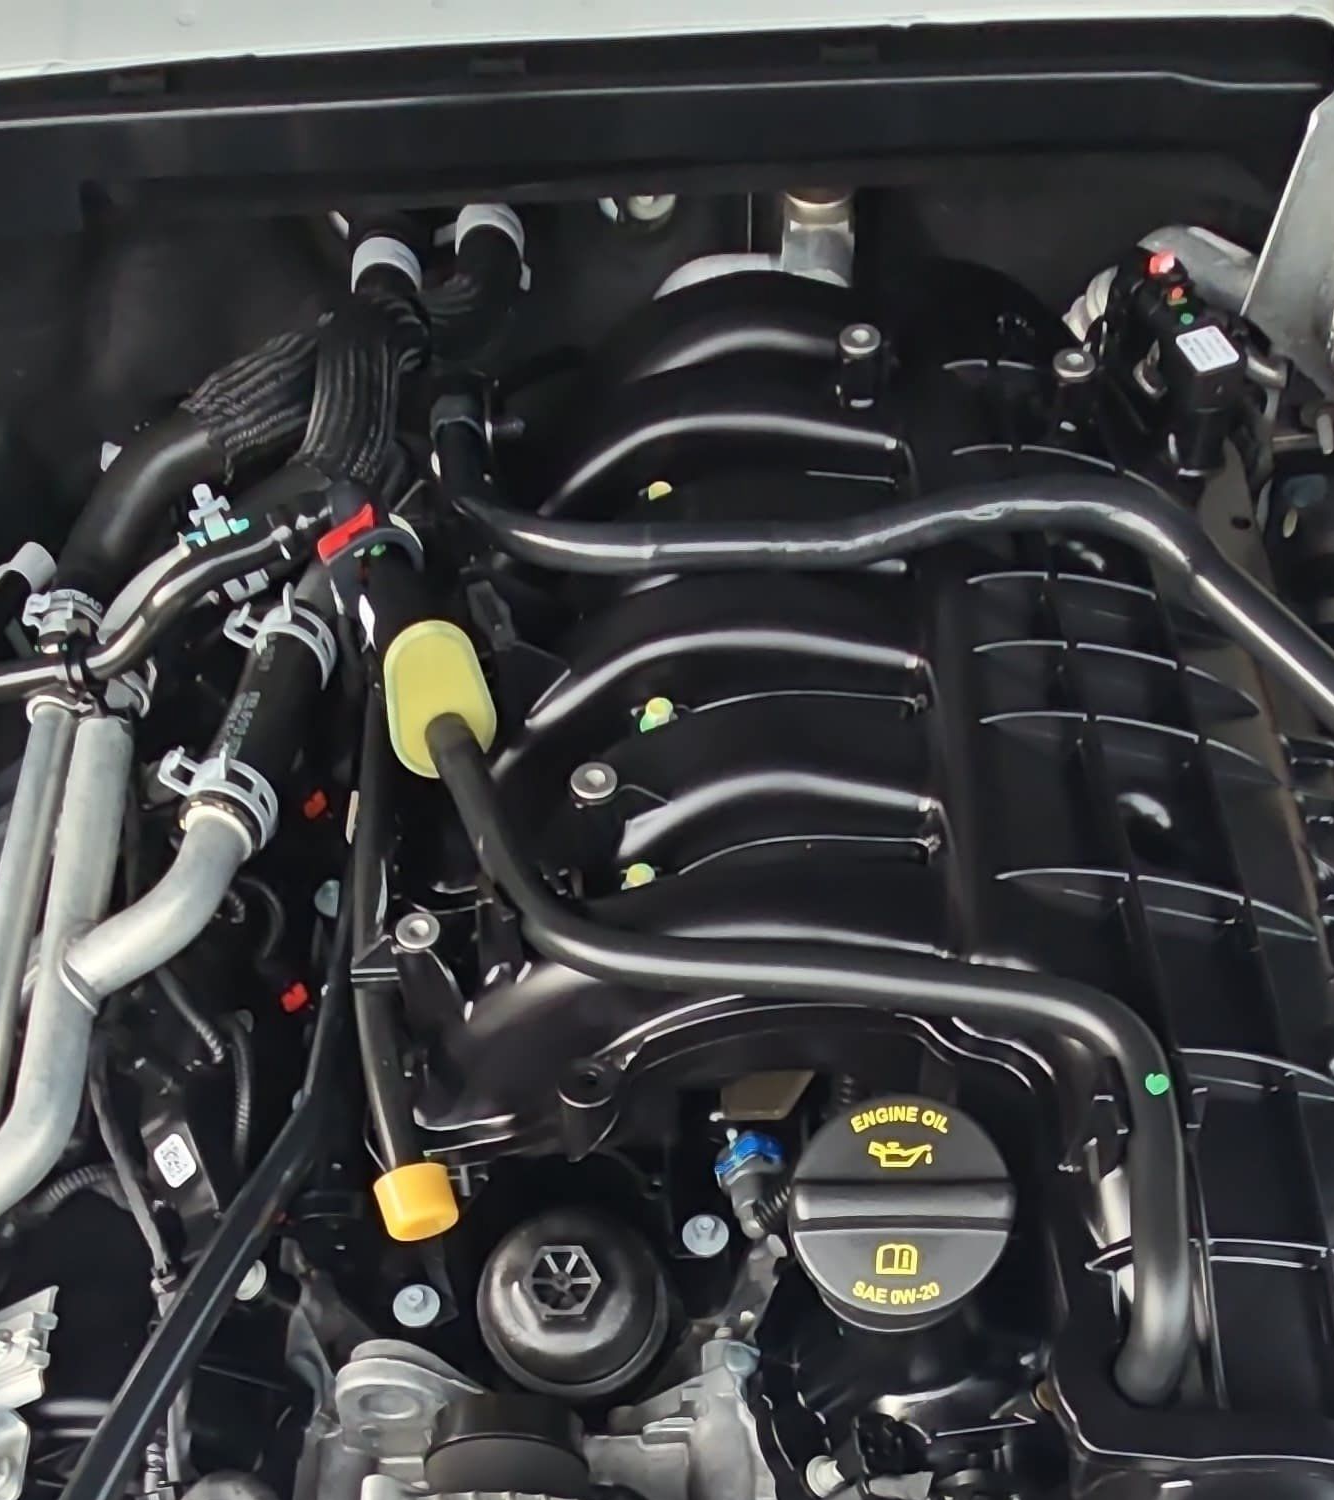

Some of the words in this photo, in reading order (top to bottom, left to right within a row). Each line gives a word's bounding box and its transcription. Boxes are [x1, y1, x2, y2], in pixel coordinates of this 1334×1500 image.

[850, 1105, 919, 1133] ENGINE
[921, 1110, 948, 1134] OIL
[852, 1280, 888, 1305] SAE
[890, 1281, 940, 1305] 0W-20
